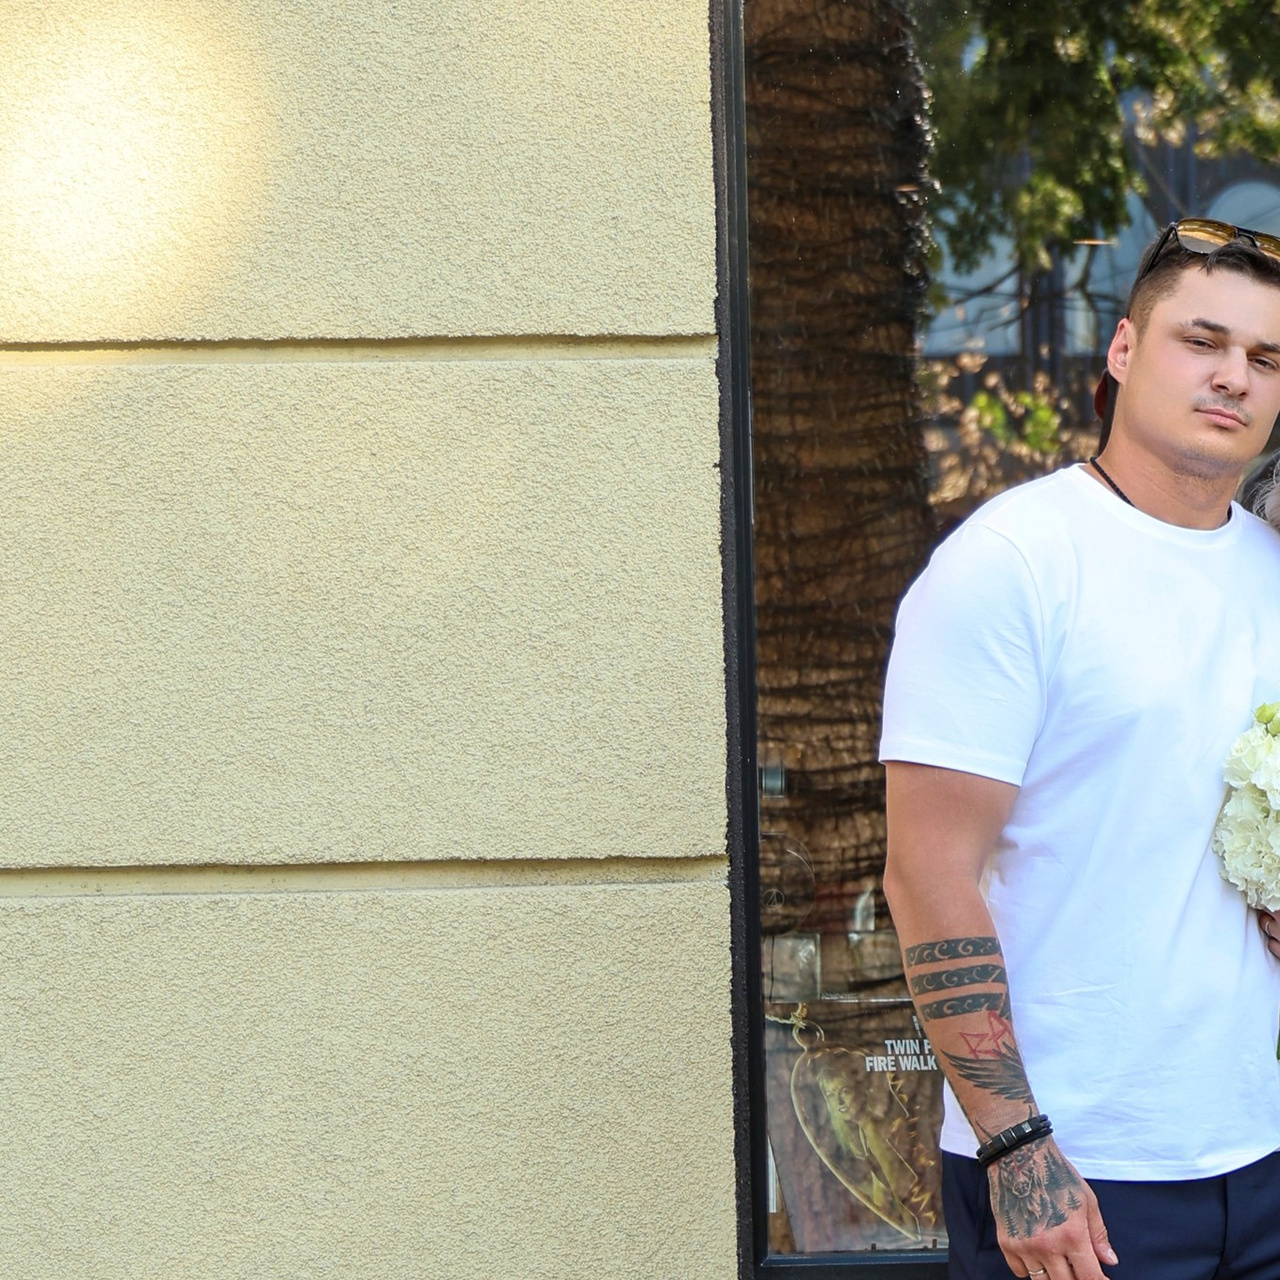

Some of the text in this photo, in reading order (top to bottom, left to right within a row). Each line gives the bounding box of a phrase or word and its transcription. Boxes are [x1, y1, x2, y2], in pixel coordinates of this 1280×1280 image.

[885, 1039, 920, 1055] TWIN
[865, 1055, 938, 1072] FIRE WALK
